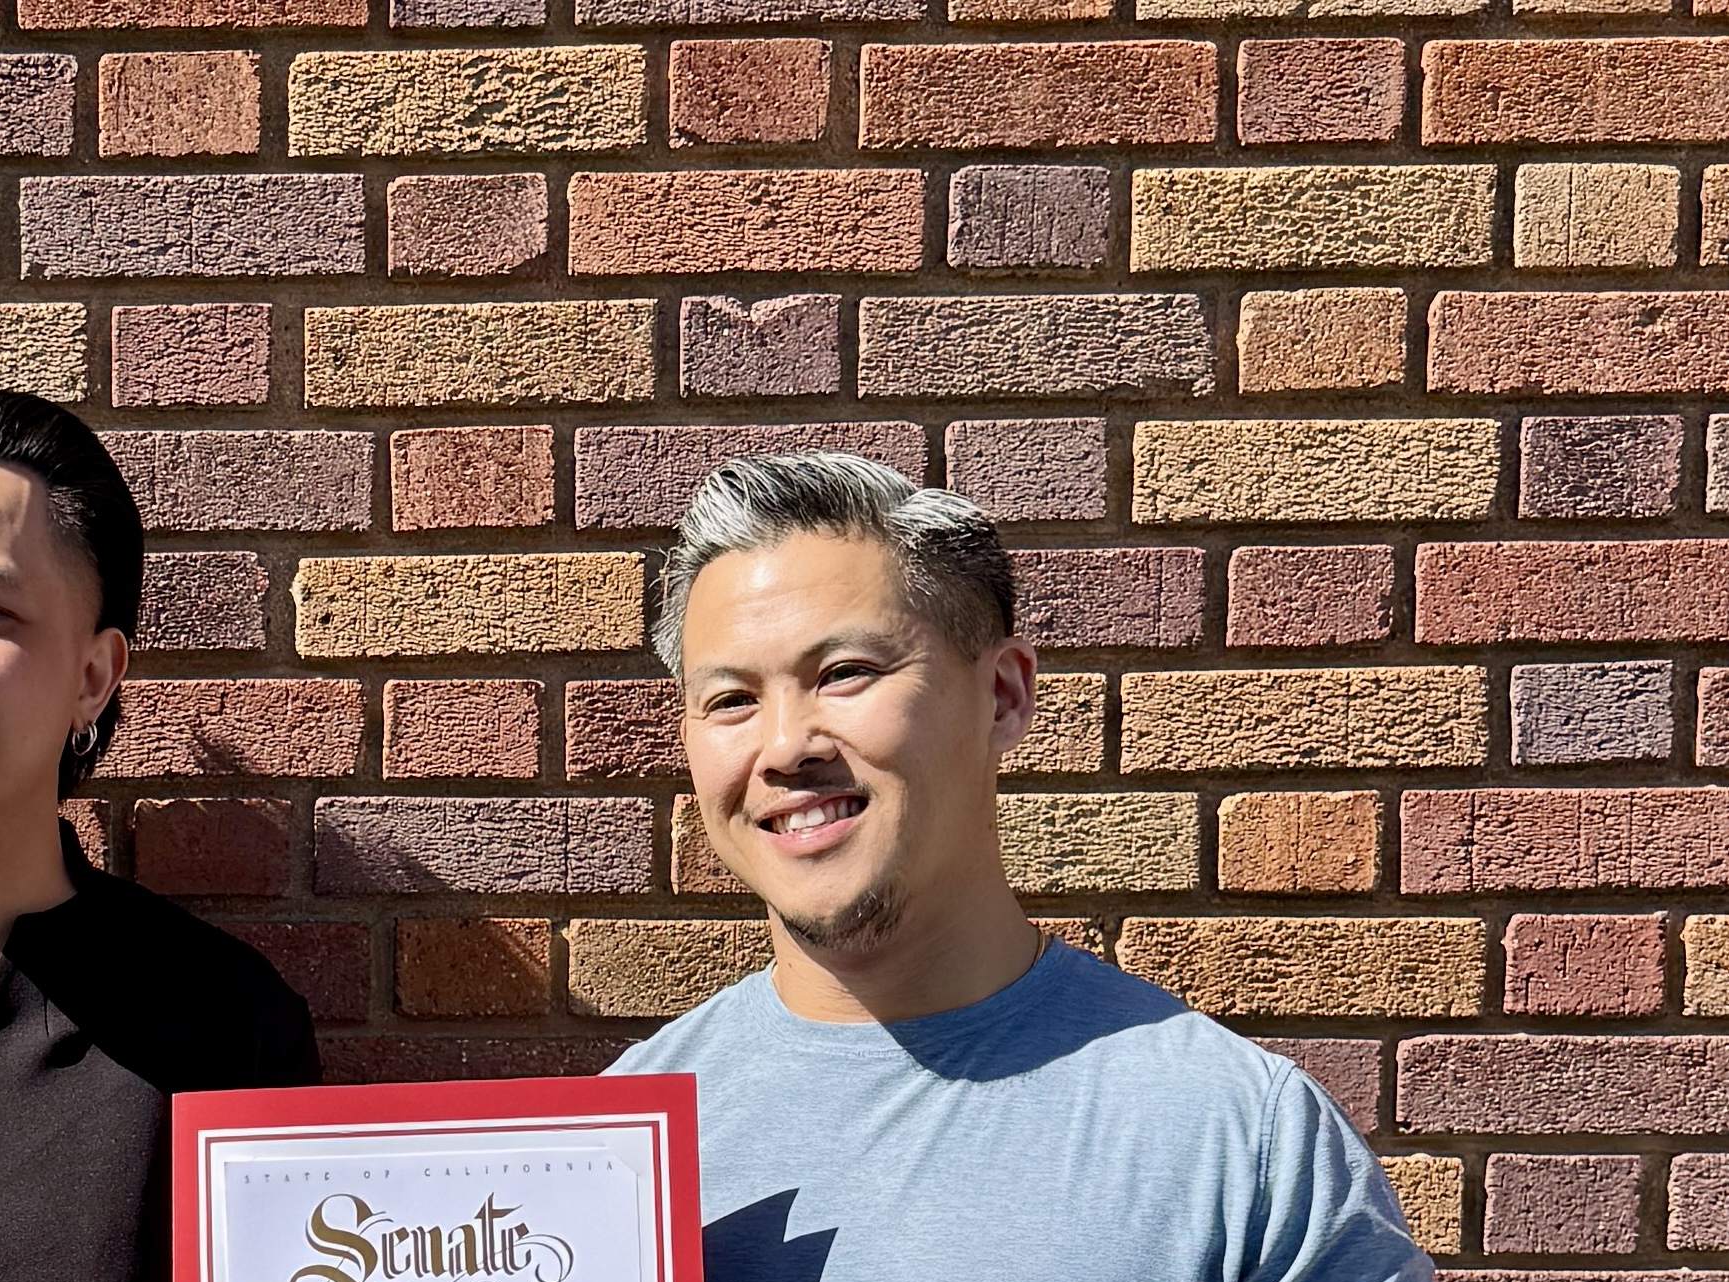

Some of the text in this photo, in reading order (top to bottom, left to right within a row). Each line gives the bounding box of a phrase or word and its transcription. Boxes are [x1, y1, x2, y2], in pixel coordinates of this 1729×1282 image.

[244, 1161, 612, 1183] STATE OF CALIFORNIA
